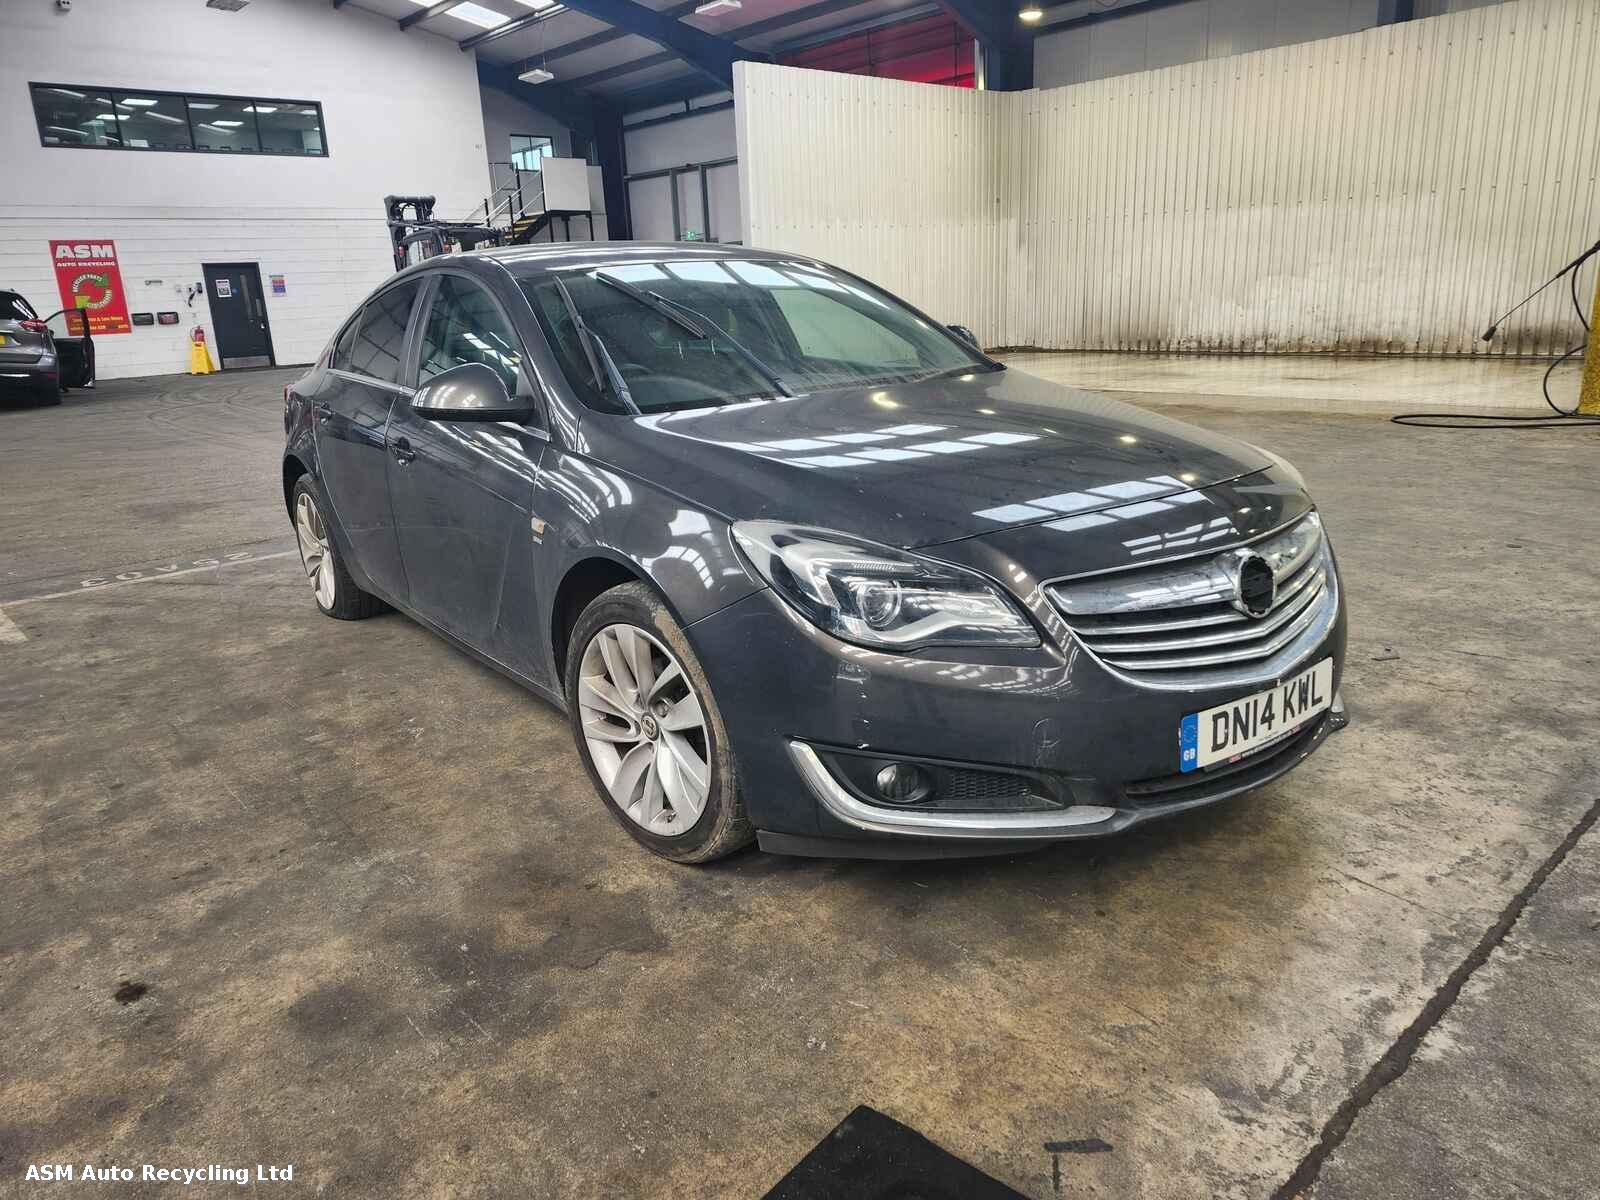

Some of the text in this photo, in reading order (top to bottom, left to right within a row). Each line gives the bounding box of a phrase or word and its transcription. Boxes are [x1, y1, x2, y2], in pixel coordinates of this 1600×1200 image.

[56, 244, 114, 258] ASM
[1211, 693, 1275, 753] DN14
[1283, 671, 1323, 723] KWL
[1183, 748, 1196, 761] GB
